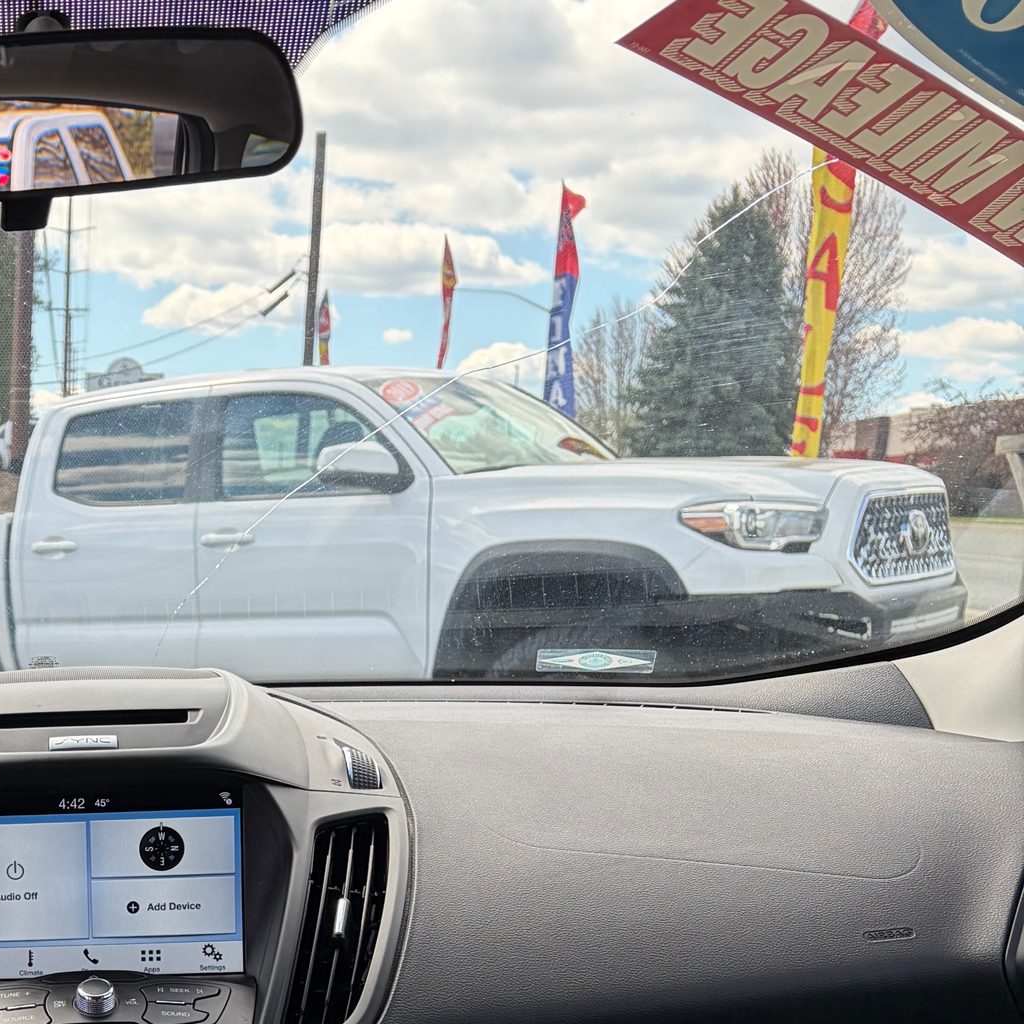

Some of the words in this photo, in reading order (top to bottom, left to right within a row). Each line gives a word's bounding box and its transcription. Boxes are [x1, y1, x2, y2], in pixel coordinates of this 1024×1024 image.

[55, 737, 111, 746] SYNC
[58, 798, 85, 810] 4:42
[23, 891, 38, 900] Off
[147, 902, 166, 911] Add
[169, 901, 201, 911] Device
[143, 966, 160, 974] Apps
[199, 964, 226, 972] Settings
[19, 969, 43, 977] Climate
